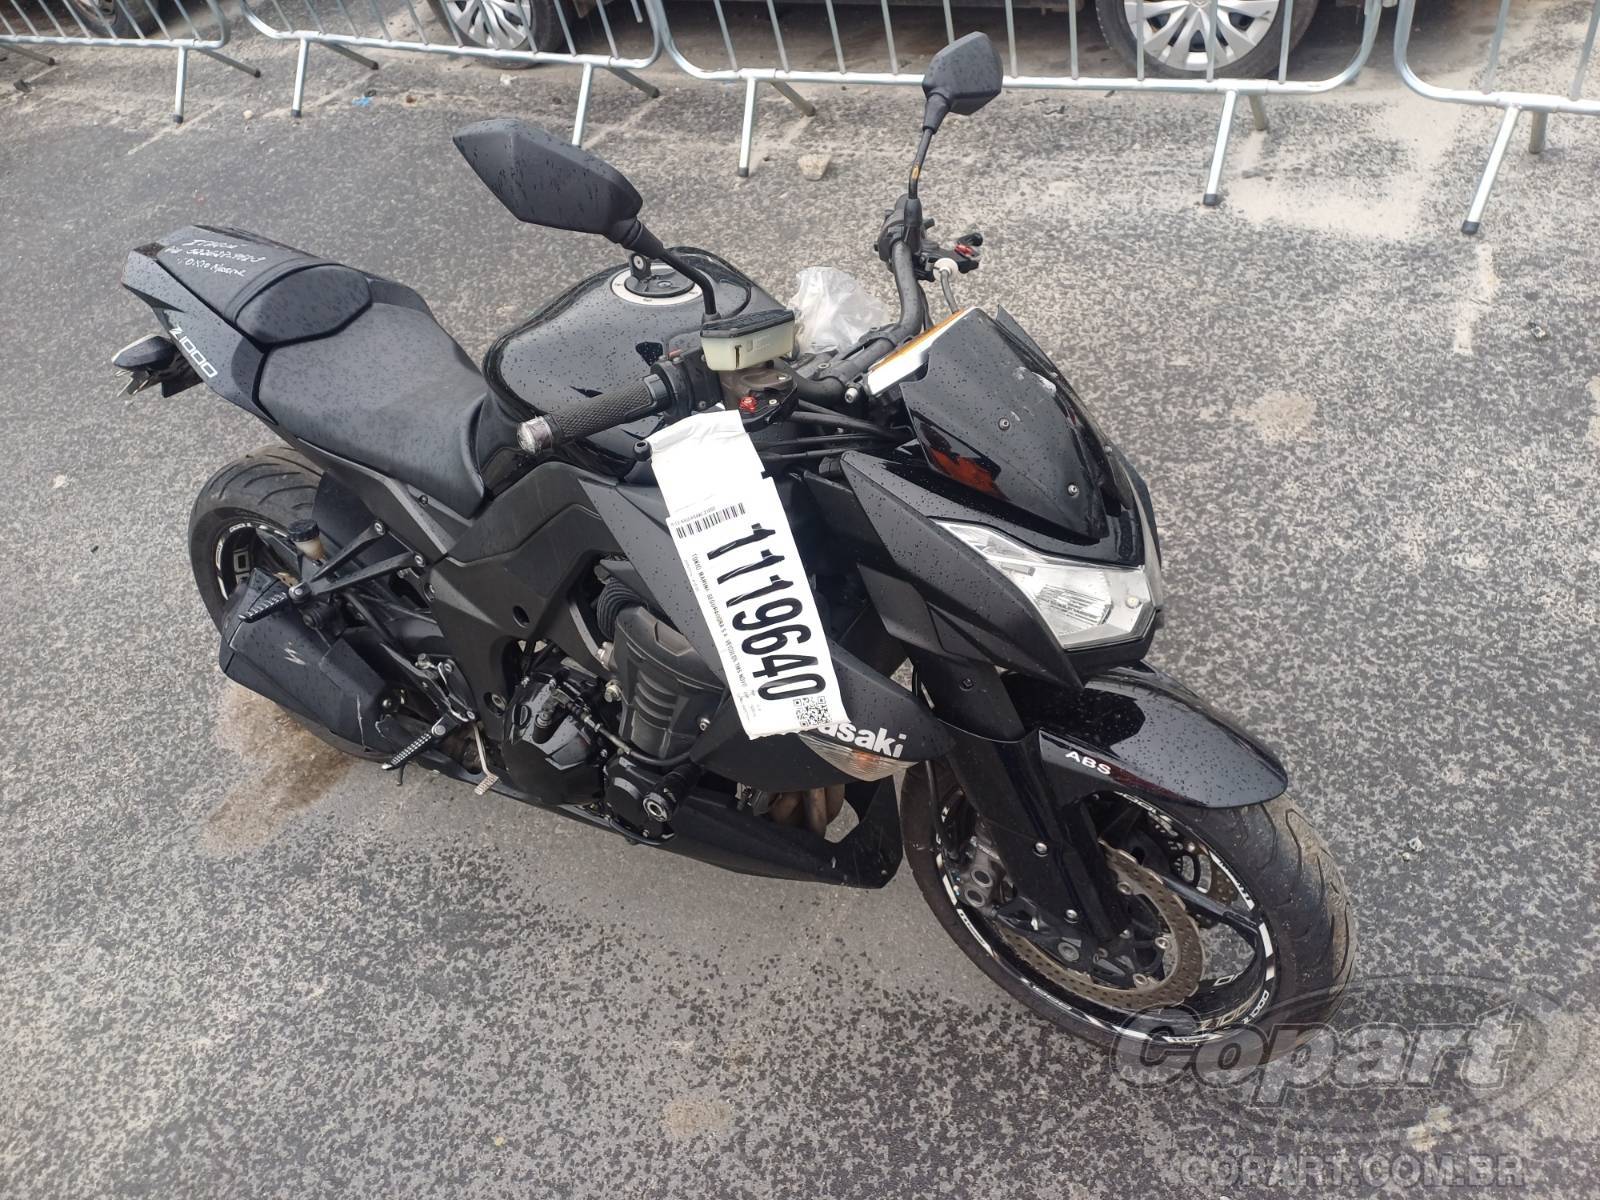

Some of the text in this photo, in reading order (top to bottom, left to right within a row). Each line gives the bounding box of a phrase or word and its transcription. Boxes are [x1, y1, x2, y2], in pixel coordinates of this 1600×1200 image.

[169, 326, 218, 378] Z1000
[707, 523, 826, 700] 1119640
[818, 723, 907, 758] asaki
[1065, 751, 1111, 775] ABS
